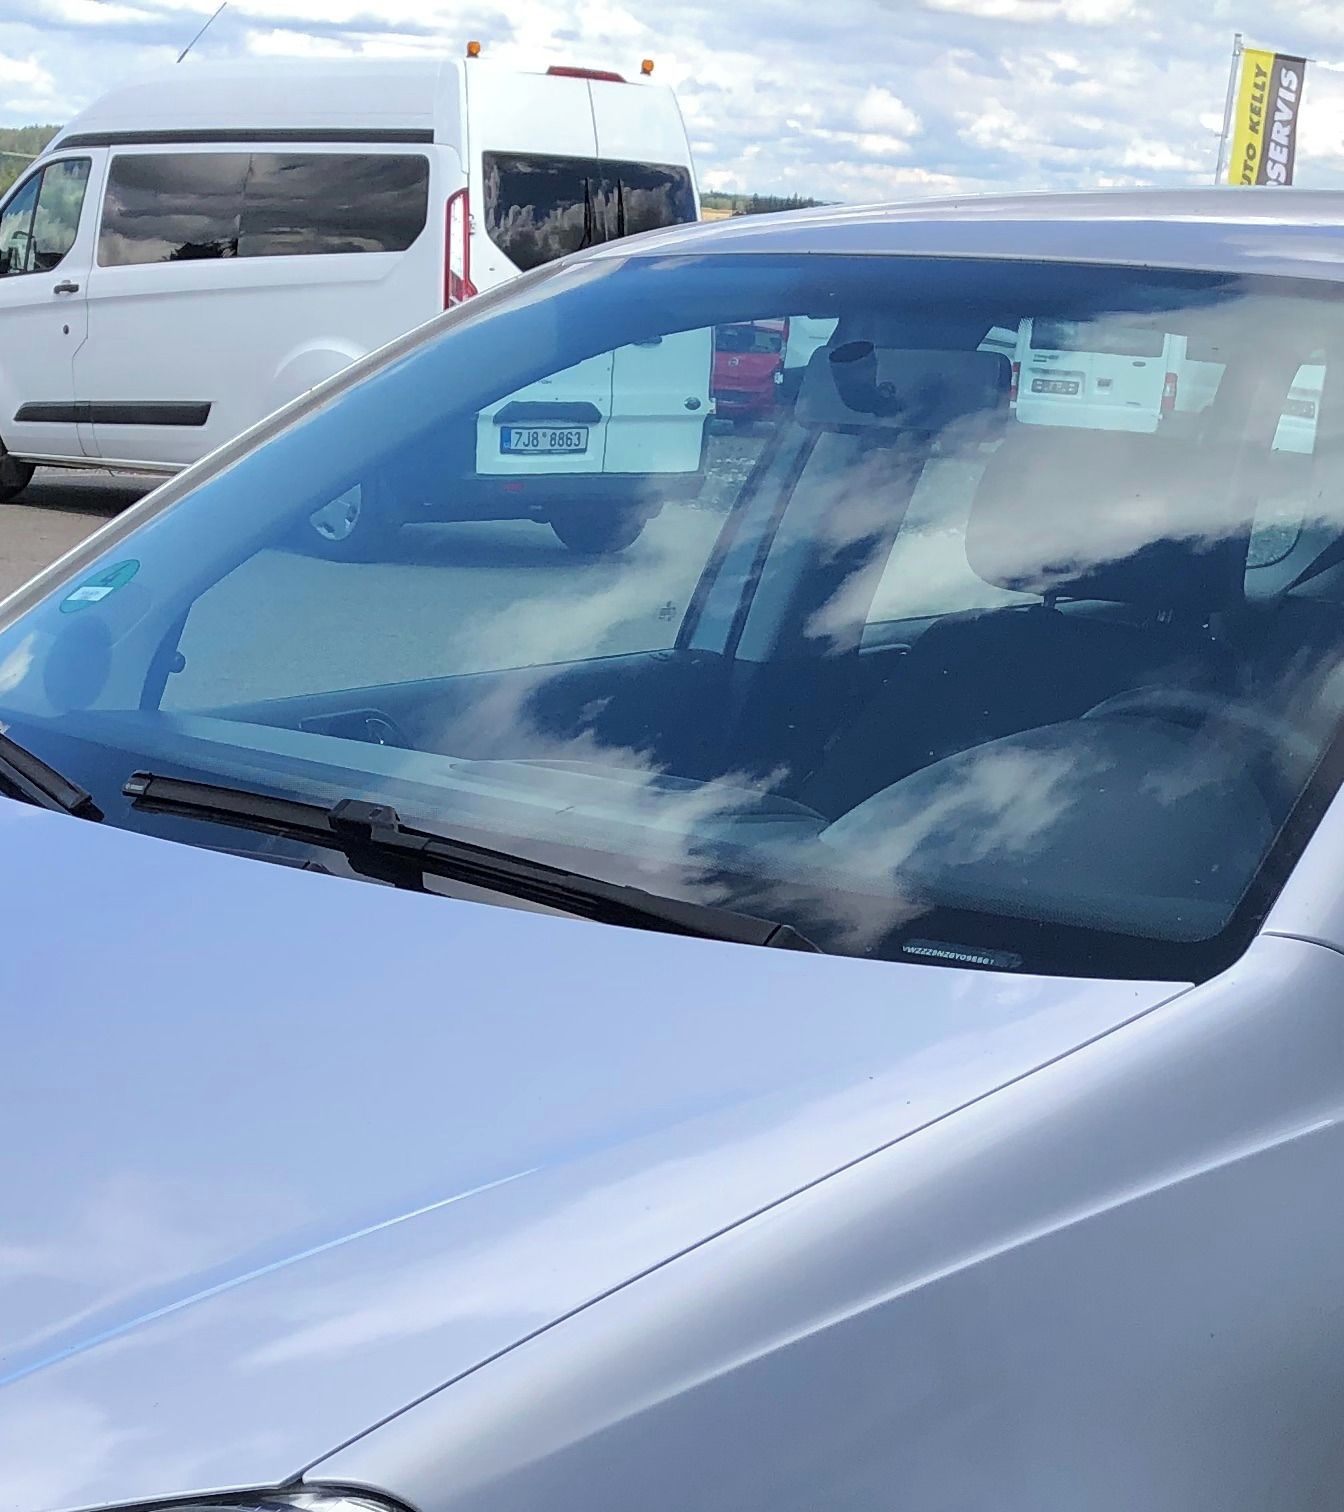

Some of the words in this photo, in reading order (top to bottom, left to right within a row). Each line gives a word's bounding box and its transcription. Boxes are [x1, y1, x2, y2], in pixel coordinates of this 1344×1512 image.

[1248, 63, 1268, 135] KELLY
[514, 431, 539, 447] 7J8
[549, 431, 581, 447] 8863
